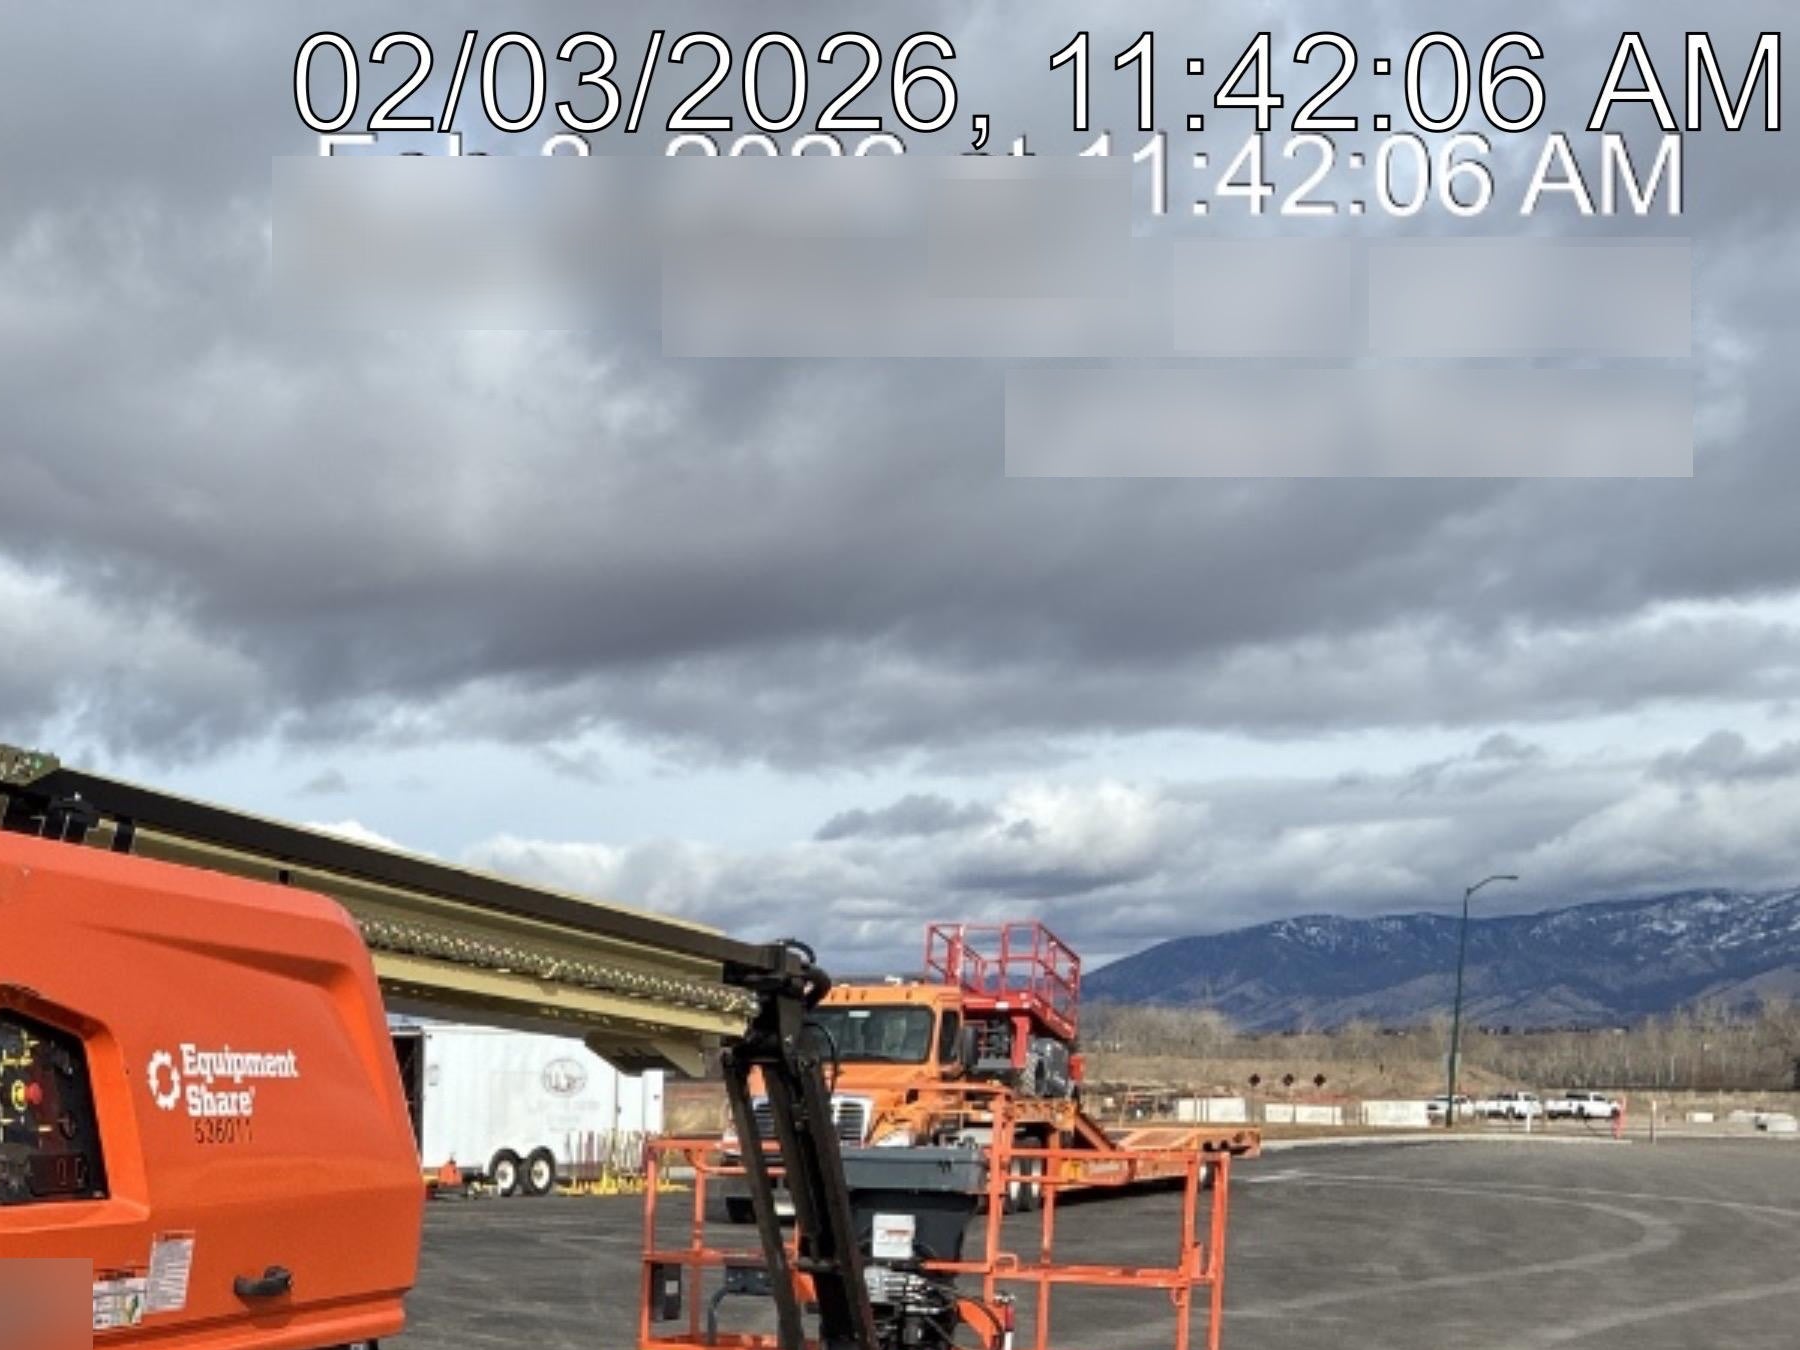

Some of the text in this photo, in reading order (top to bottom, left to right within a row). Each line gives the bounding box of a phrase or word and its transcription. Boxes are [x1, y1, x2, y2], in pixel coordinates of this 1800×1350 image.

[179, 1043, 299, 1084] Equipment
[185, 1083, 253, 1117] Share
[194, 1117, 253, 1144] 536011
